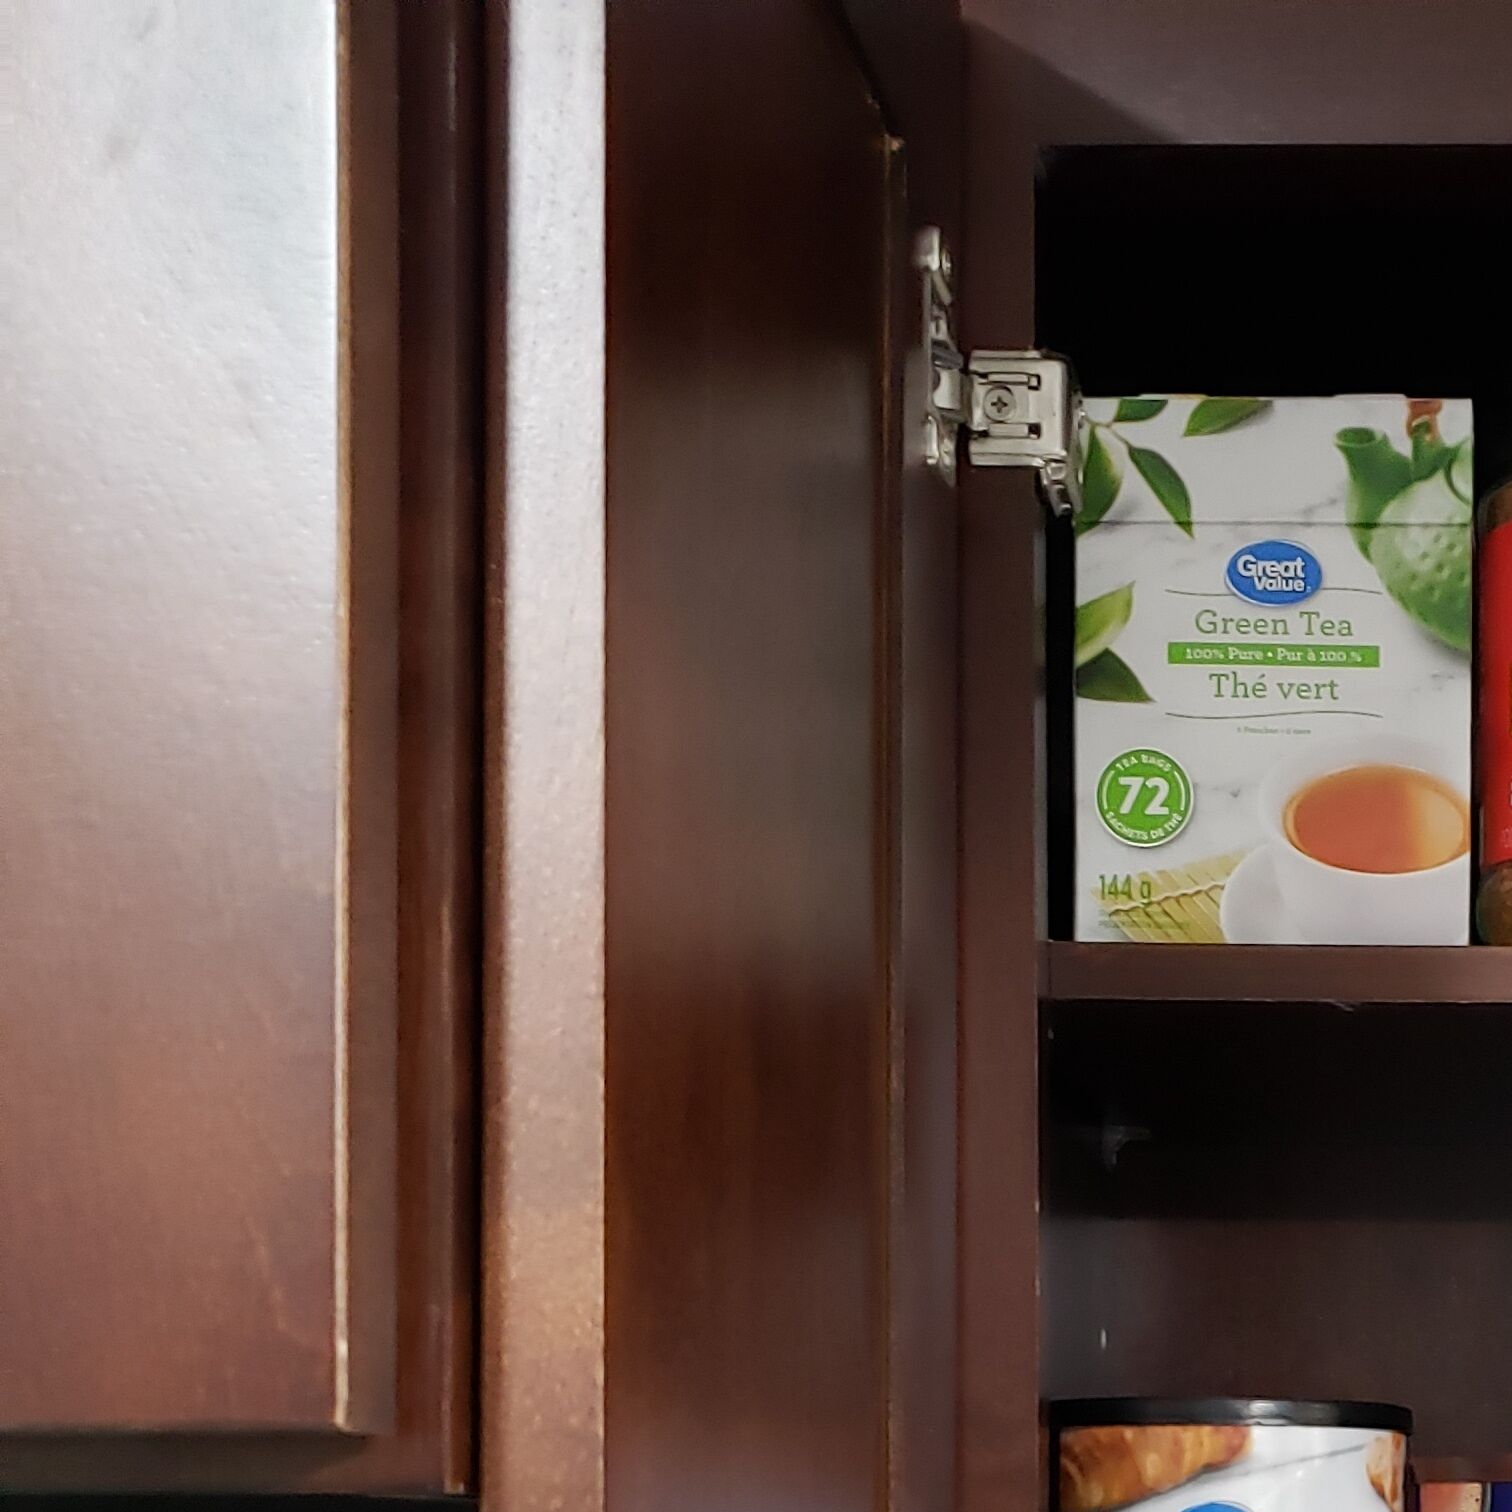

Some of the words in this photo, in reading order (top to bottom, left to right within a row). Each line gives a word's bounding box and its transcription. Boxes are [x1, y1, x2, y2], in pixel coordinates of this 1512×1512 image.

[1237, 554, 1305, 579] Great
[1254, 577, 1306, 592] Value
[1195, 610, 1290, 635] Green
[1300, 611, 1353, 636] Tea
[1186, 647, 1224, 660] 100%
[1228, 647, 1263, 661] Pure
[1276, 648, 1302, 661] Pur
[1307, 647, 1316, 662] à
[1320, 650, 1346, 662] 100
[1209, 671, 1268, 699] Thé
[1277, 679, 1339, 700] vert
[1115, 756, 1138, 771] TEA
[1118, 776, 1170, 815] 72
[1099, 874, 1134, 900] 144
[1140, 881, 1152, 906] g
